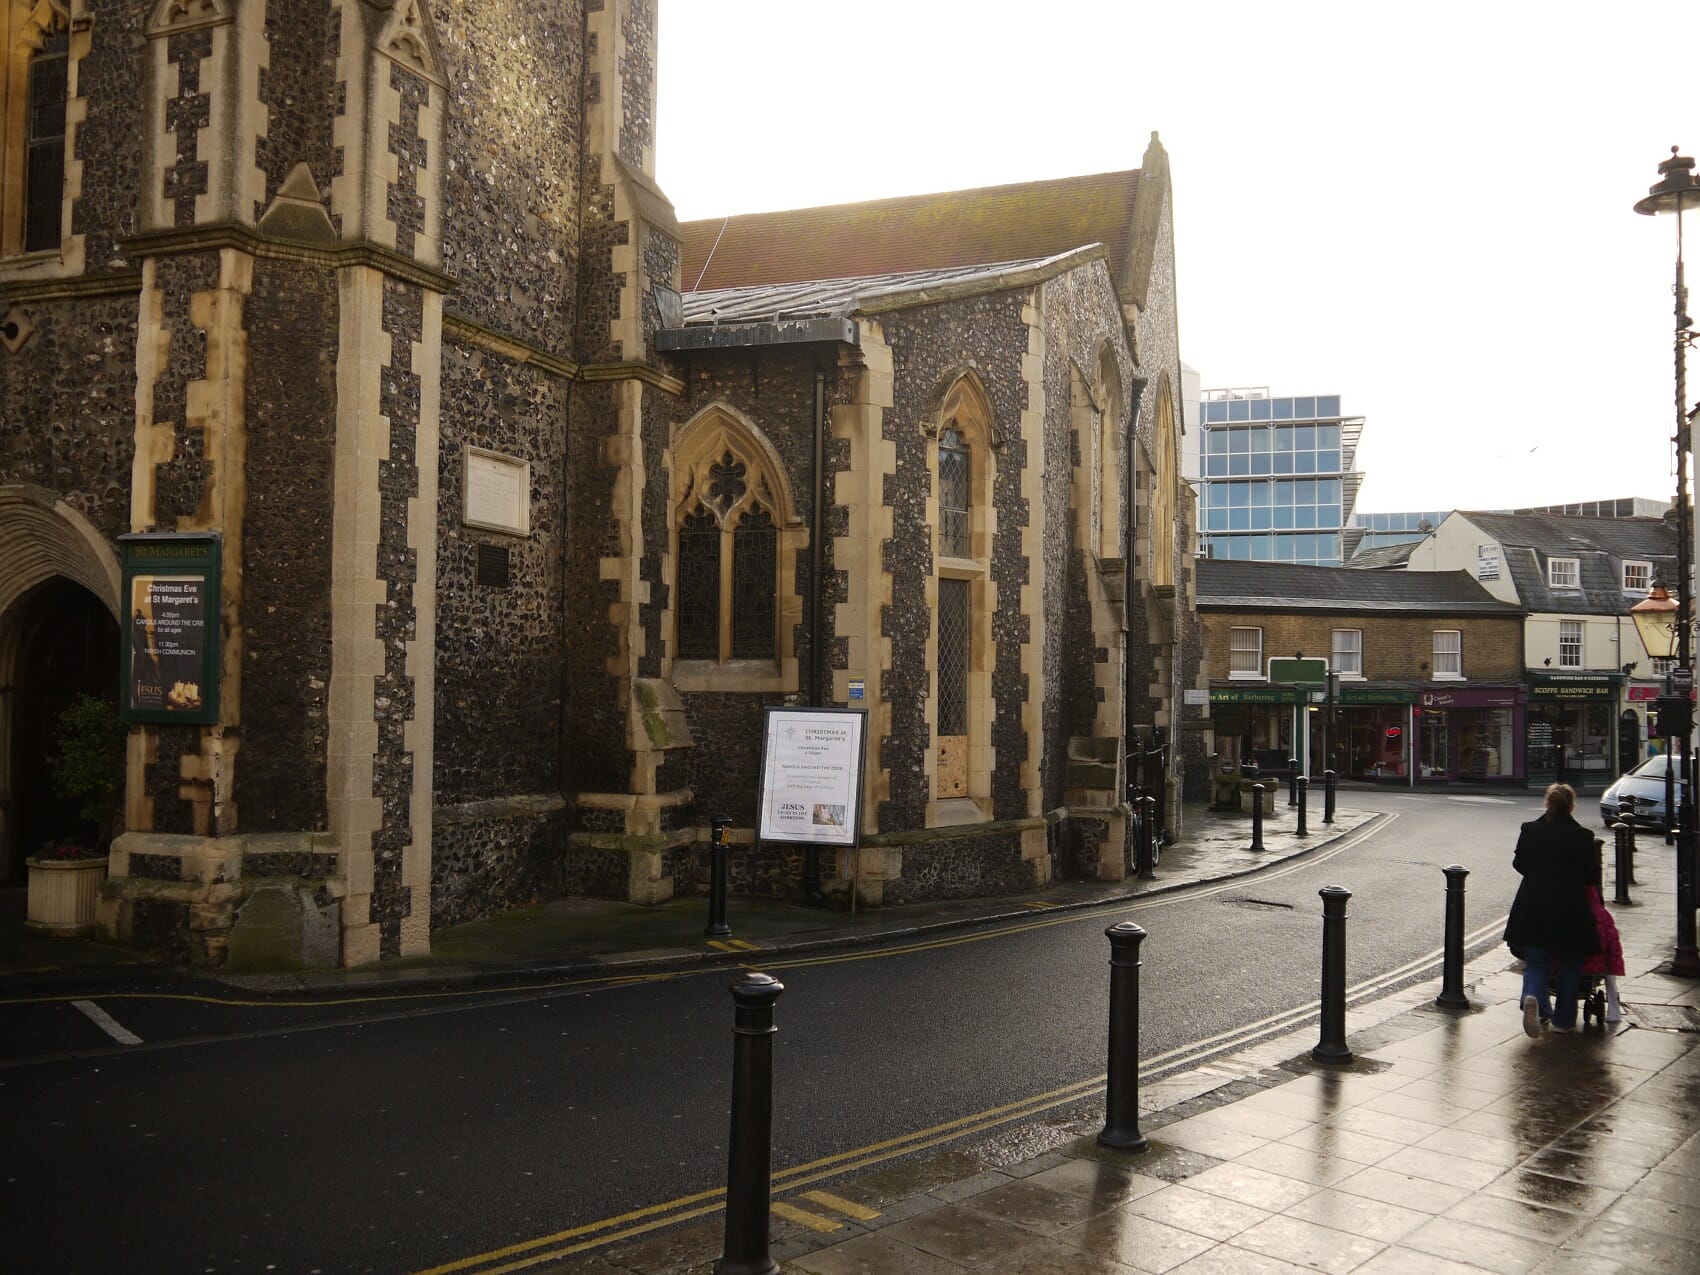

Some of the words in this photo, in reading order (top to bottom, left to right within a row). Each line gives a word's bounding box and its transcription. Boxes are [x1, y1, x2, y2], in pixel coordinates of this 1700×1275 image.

[147, 584, 182, 592] Christmas
[184, 584, 197, 593] Eve
[152, 595, 160, 604] St
[162, 595, 199, 606] Margaret's
